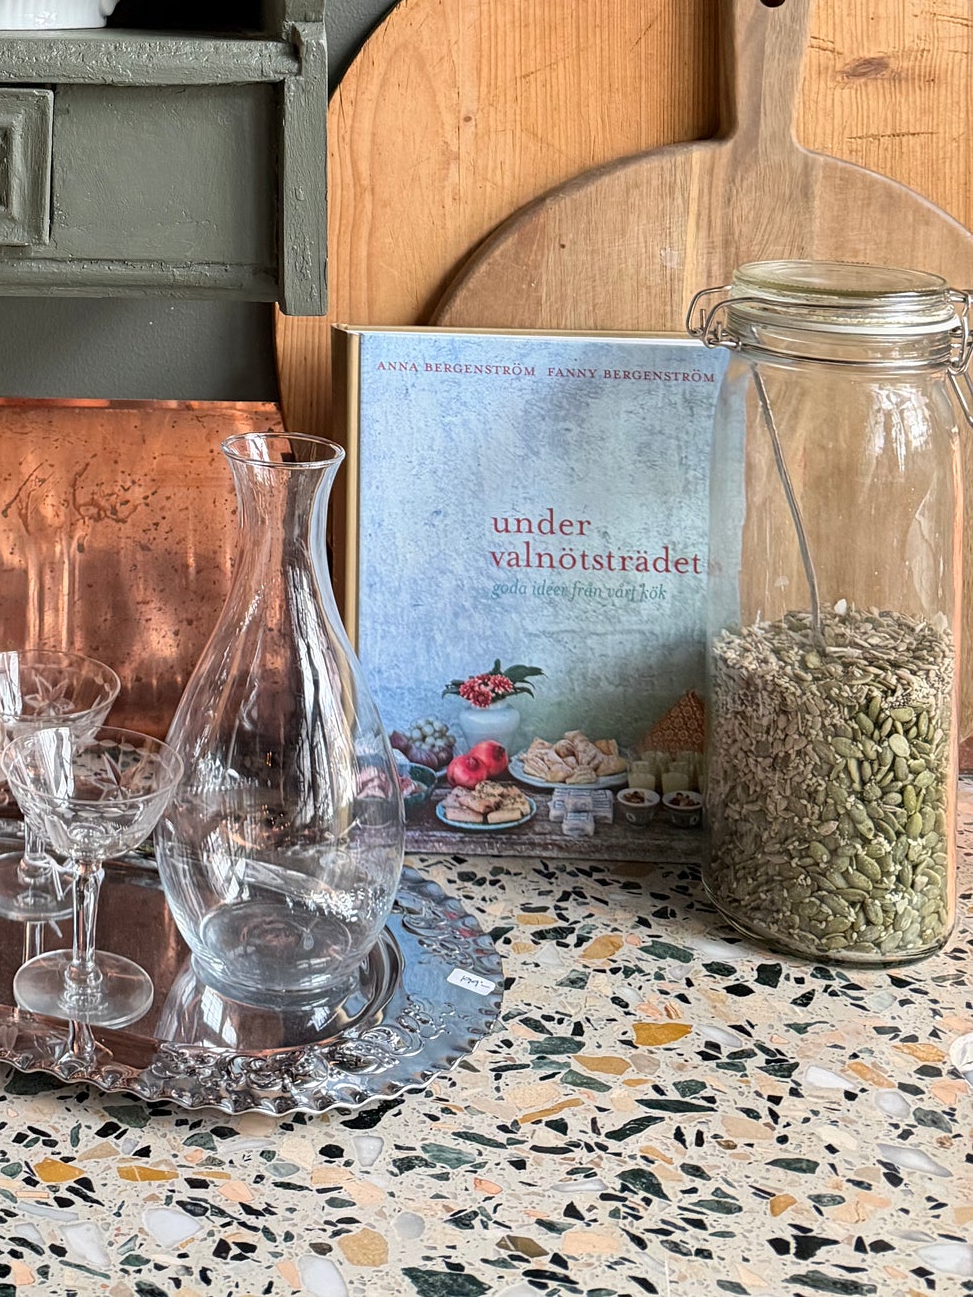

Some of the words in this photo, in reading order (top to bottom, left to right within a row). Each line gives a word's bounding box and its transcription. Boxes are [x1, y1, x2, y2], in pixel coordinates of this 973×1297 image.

[377, 361, 418, 372] ANNA
[424, 362, 536, 376] BERGENSTRÖM
[547, 367, 597, 379] FANNY
[603, 369, 715, 383] BERGENSTRÖM
[491, 508, 592, 536] under
[491, 541, 704, 575] valnötsträdet
[491, 579, 527, 599] goda
[532, 579, 566, 597] idéer
[568, 581, 604, 602] från
[606, 582, 636, 602] vårt
[639, 582, 667, 602] kök
